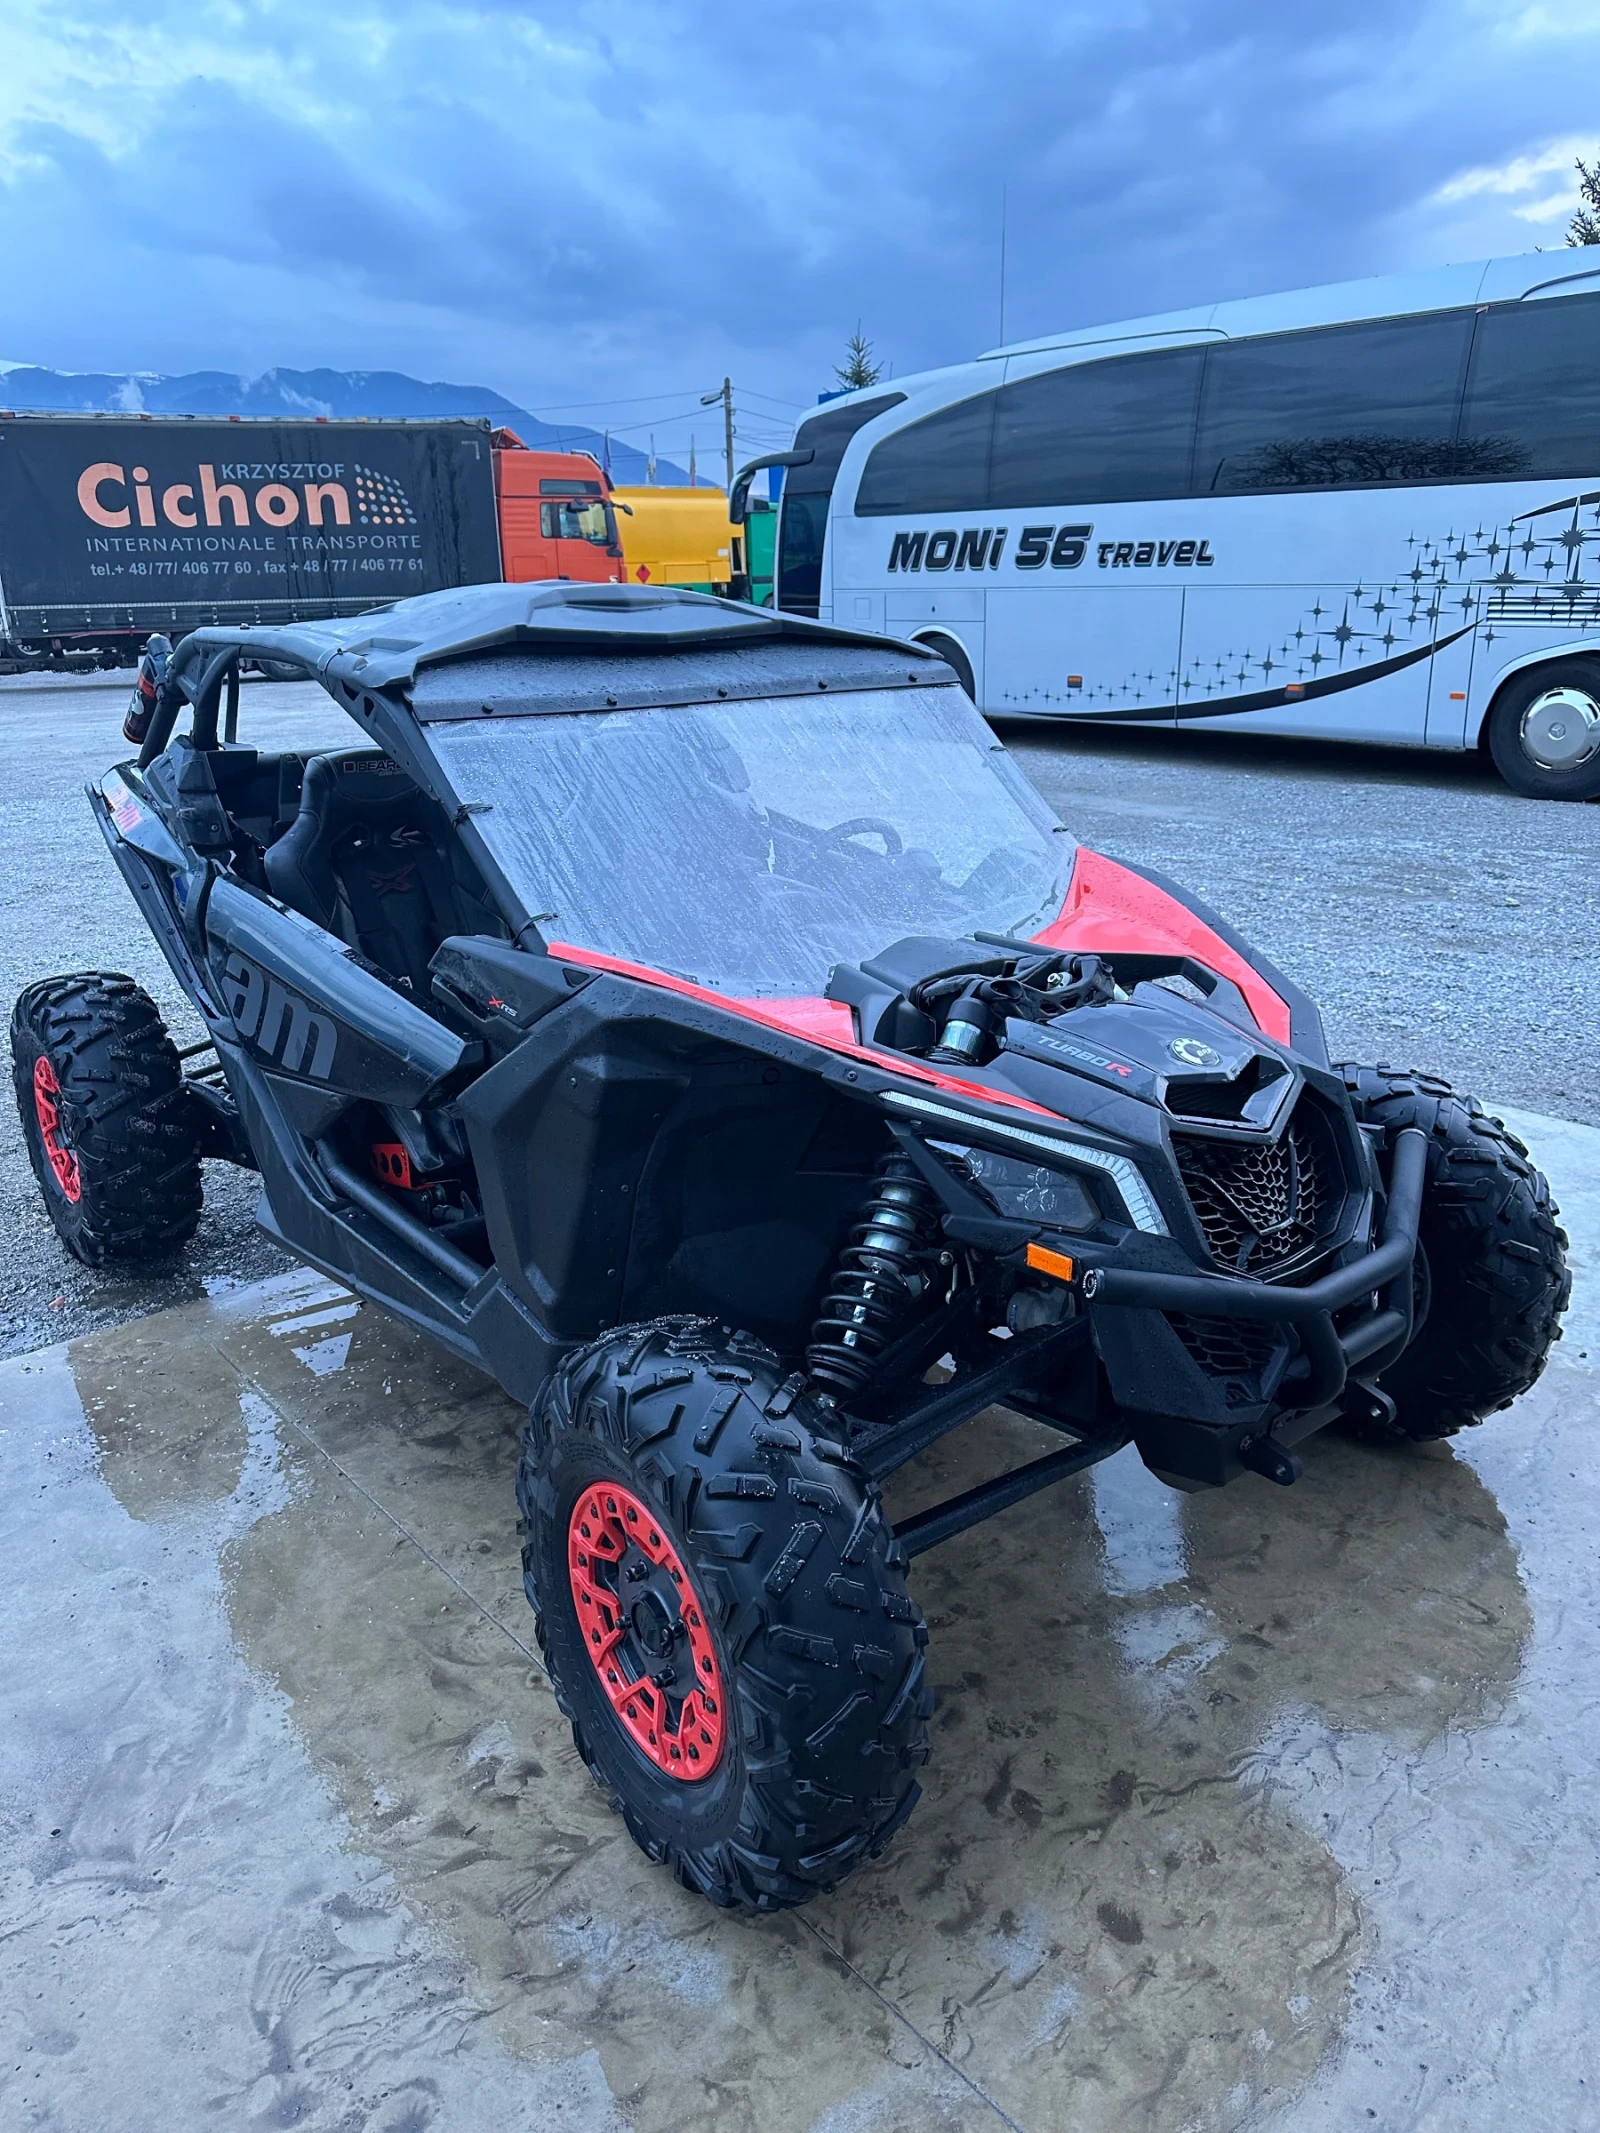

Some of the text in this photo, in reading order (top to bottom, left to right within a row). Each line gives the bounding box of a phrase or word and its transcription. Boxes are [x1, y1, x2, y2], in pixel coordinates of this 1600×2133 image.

[221, 464, 345, 479] KRZYSZTOF
[77, 462, 351, 528] Cichon
[86, 535, 422, 552] INTERNATIONALE TRANSPORTE
[1014, 522, 1094, 569] 56
[182, 562, 209, 575] 406
[212, 562, 230, 574] 77
[234, 561, 252, 574] 60
[263, 560, 287, 574] fax
[303, 560, 320, 572] 48
[360, 559, 385, 571] 406
[388, 559, 404, 571] 77
[408, 558, 423, 571] 61
